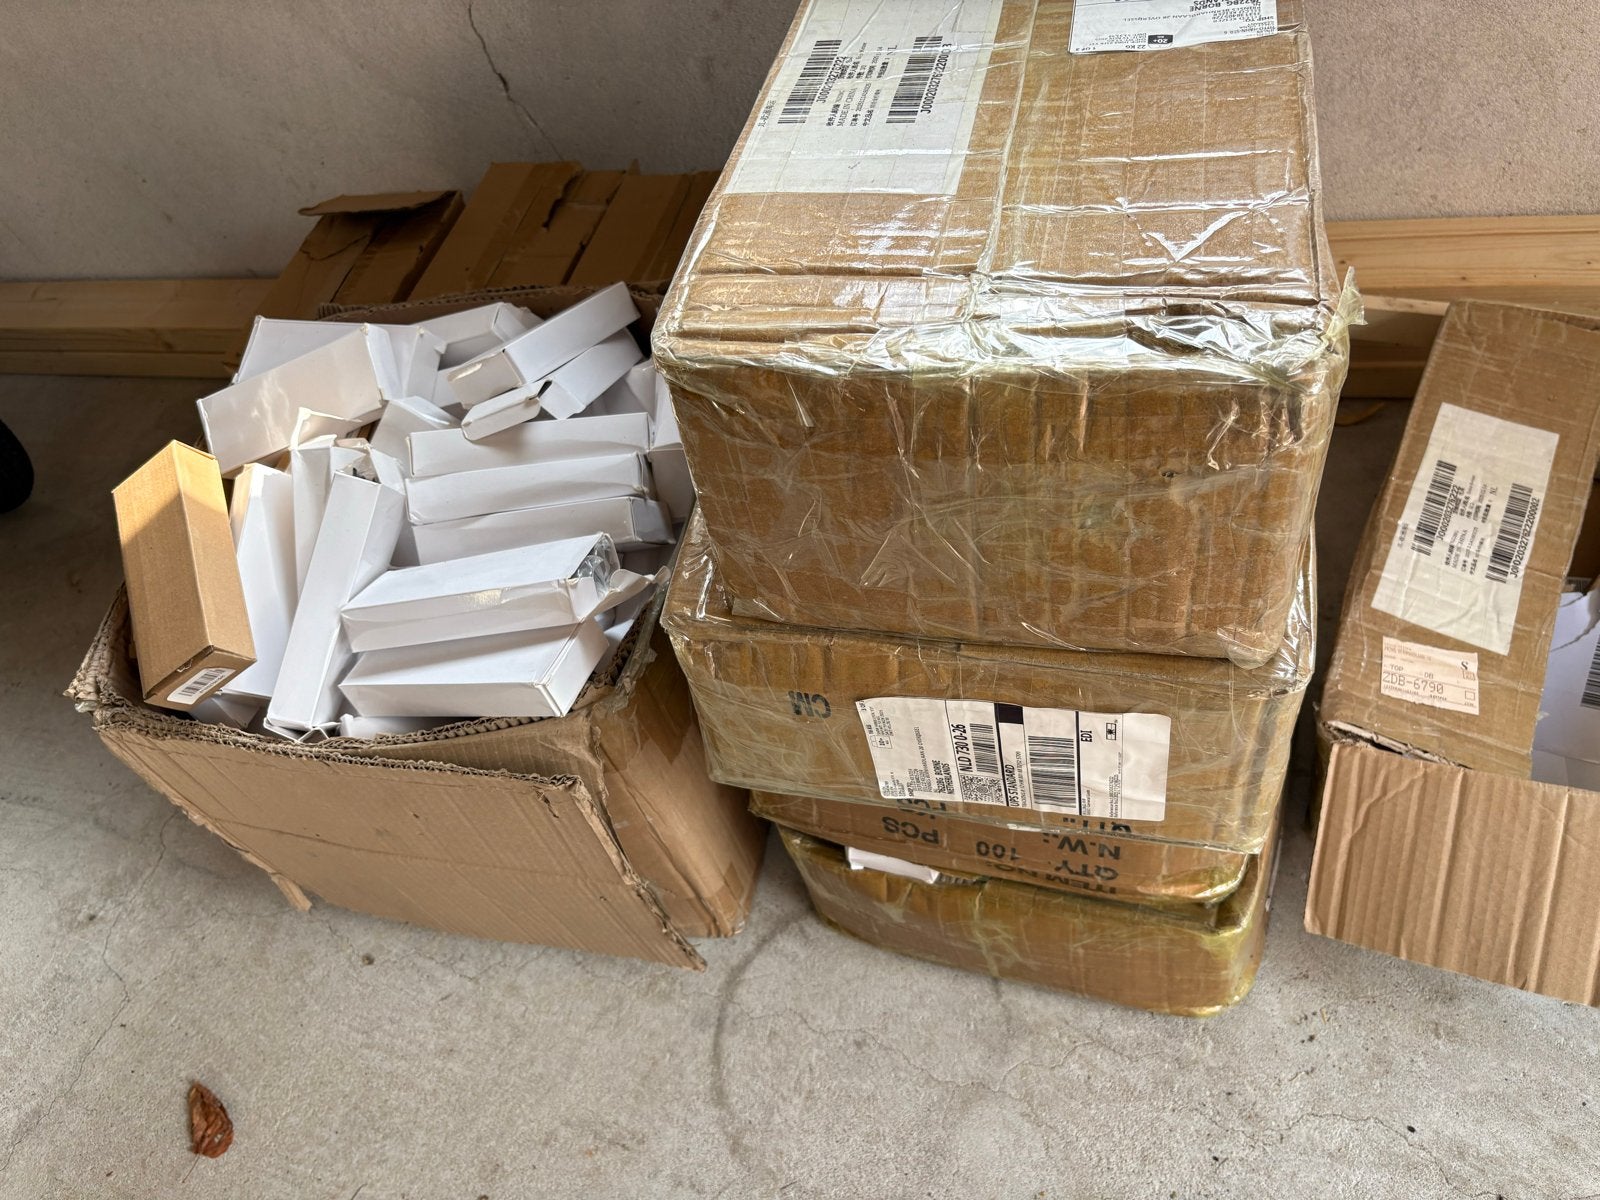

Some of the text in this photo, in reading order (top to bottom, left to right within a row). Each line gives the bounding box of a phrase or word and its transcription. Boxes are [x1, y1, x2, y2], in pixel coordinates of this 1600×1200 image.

[1190, 2, 1221, 12] BORNE
[1382, 671, 1444, 694] ZDB-6790
[951, 724, 973, 773] NLD 730 0-26
[1080, 730, 1092, 743] EDI
[941, 763, 955, 794] NETHERLANDS
[1005, 764, 1020, 807] UPS STANDARD
[882, 816, 939, 844] PCS
[976, 841, 1020, 861] 100
